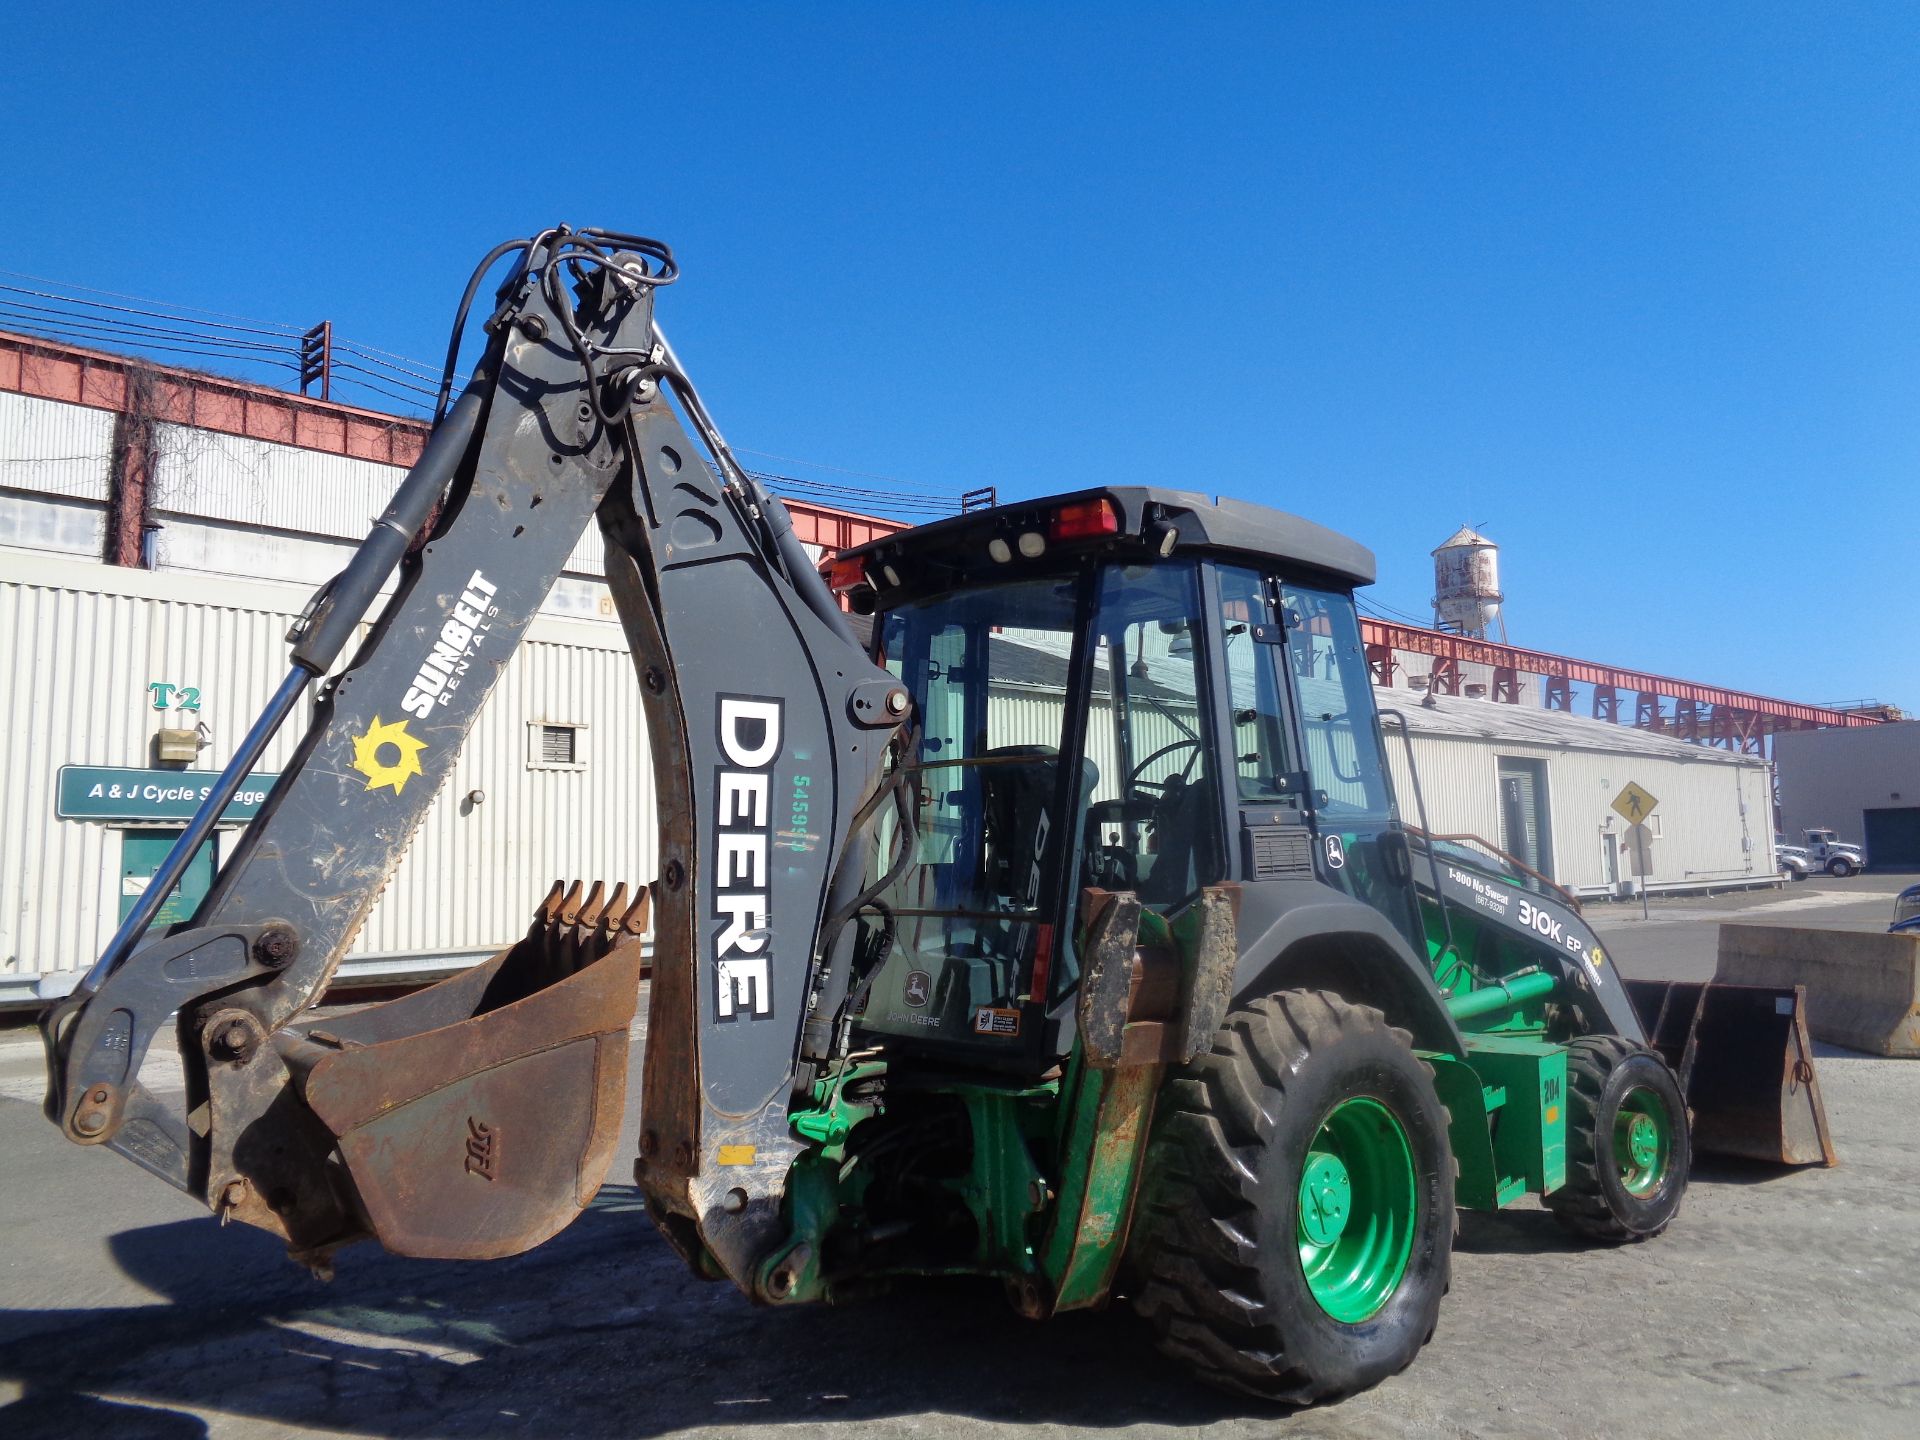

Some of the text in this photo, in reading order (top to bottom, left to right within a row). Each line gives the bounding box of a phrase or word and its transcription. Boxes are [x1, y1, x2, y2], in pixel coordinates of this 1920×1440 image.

[401, 569, 498, 719] SUNBELT
[438, 605, 499, 706] RENTALS
[148, 682, 201, 711] T2
[88, 783, 265, 806] A & J Cycle Sage
[716, 699, 780, 1017] DEERE
[1448, 867, 1509, 906] 1-800 No Sweat
[1518, 899, 1582, 952] 310K EP
[888, 1011, 941, 1028] JOHN DEERE
[1543, 1076, 1561, 1105] 204
